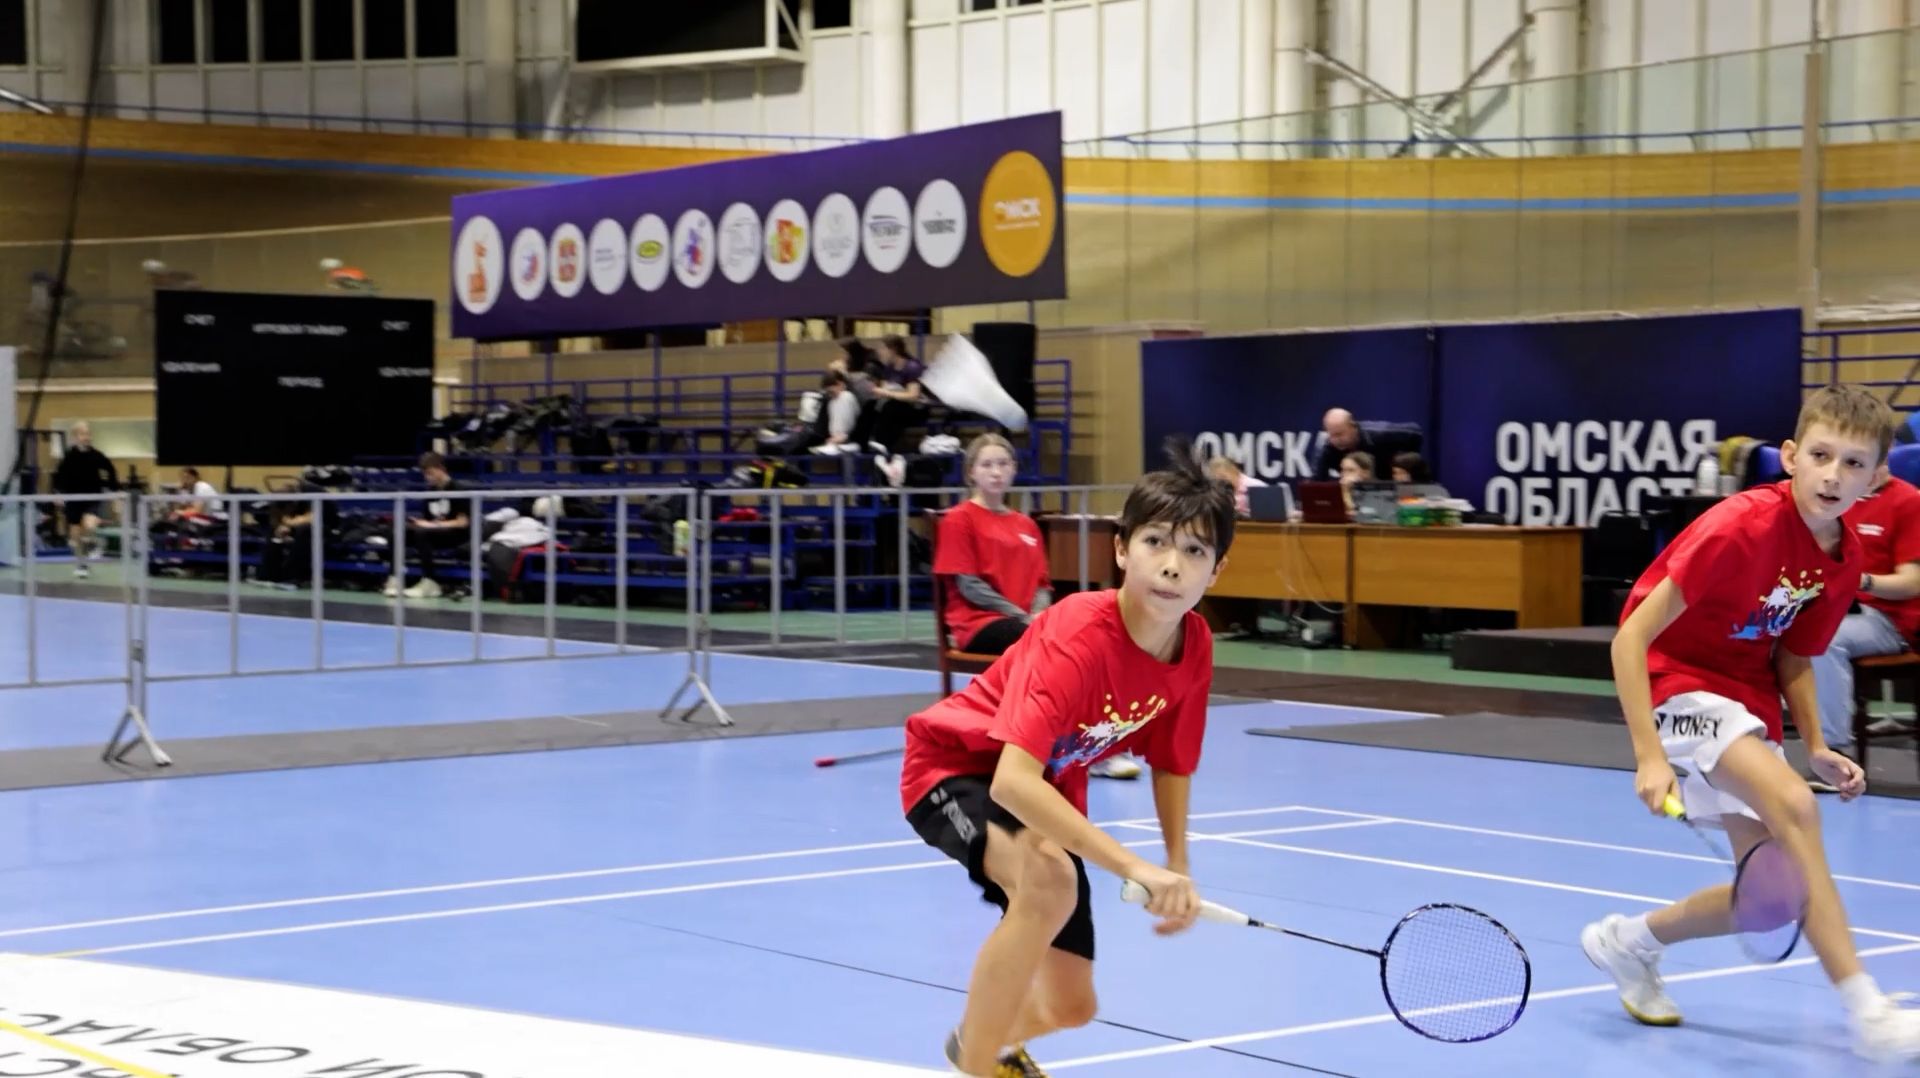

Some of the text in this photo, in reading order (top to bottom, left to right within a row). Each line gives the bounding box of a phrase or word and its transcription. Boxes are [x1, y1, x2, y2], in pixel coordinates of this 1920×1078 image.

[1191, 430, 1330, 479] ОМСК
[1496, 419, 1717, 473] ОМСКАЯ
[1484, 476, 1696, 528] ОБЛАСТ
[0, 1008, 309, 1063] ОБЛАС
